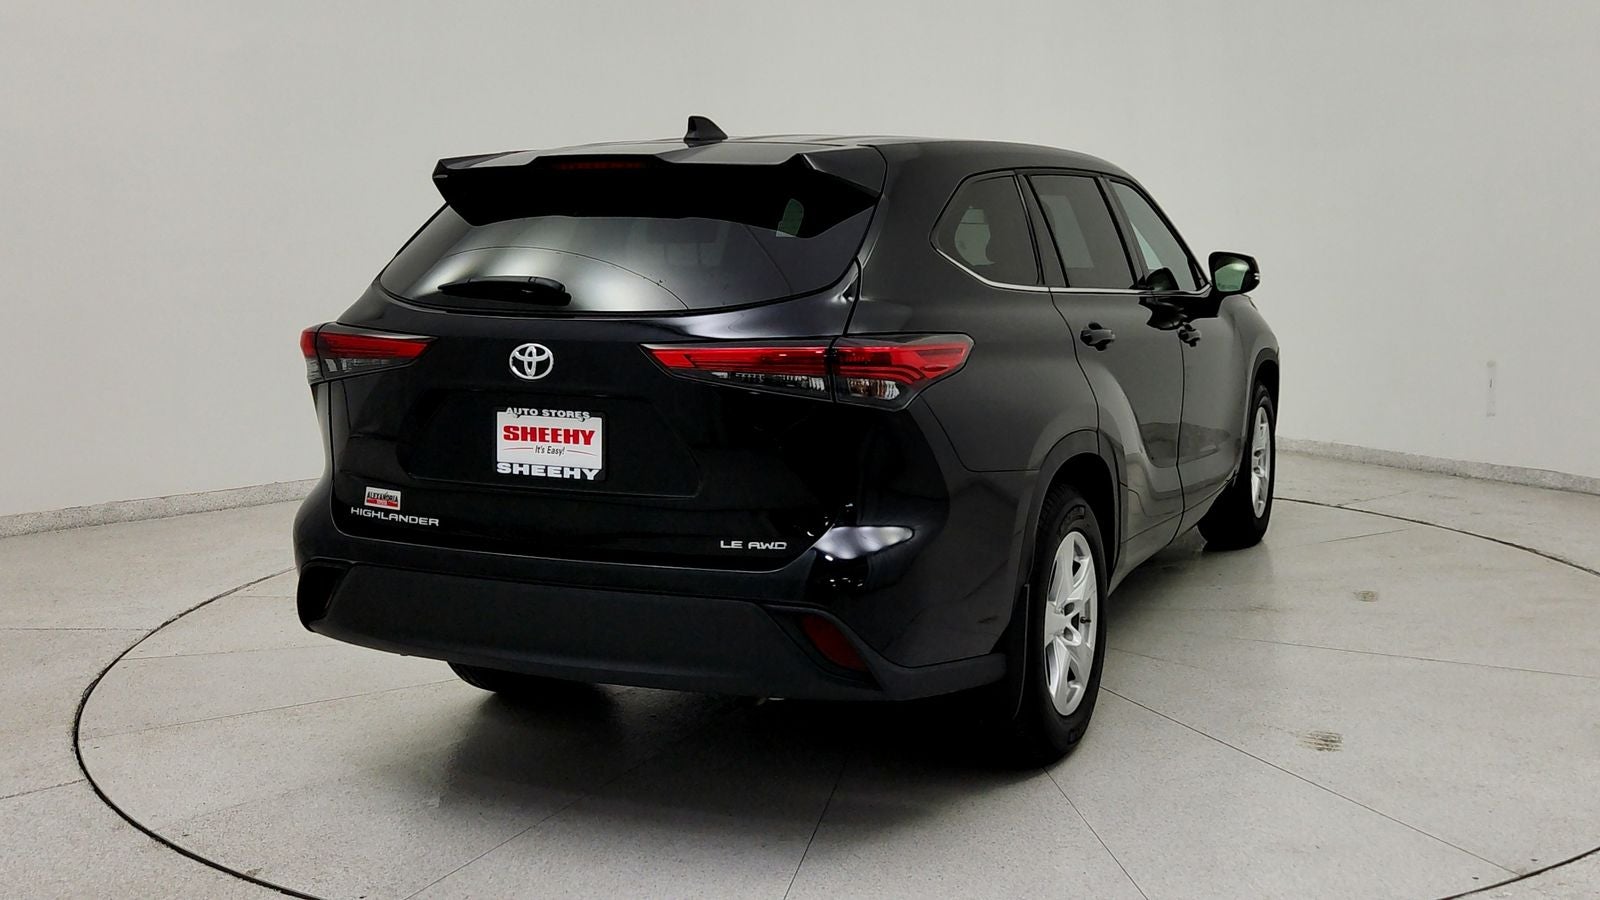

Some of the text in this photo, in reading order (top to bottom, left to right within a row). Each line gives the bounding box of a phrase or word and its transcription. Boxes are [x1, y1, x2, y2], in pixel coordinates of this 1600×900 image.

[506, 407, 590, 419] AUTO STORES
[503, 425, 595, 445] SHEEHY
[535, 445, 566, 456] It's Easy!
[496, 462, 599, 480] SHEEHY
[350, 506, 440, 526] HIGHLANDER
[720, 540, 787, 550] LE AWD
